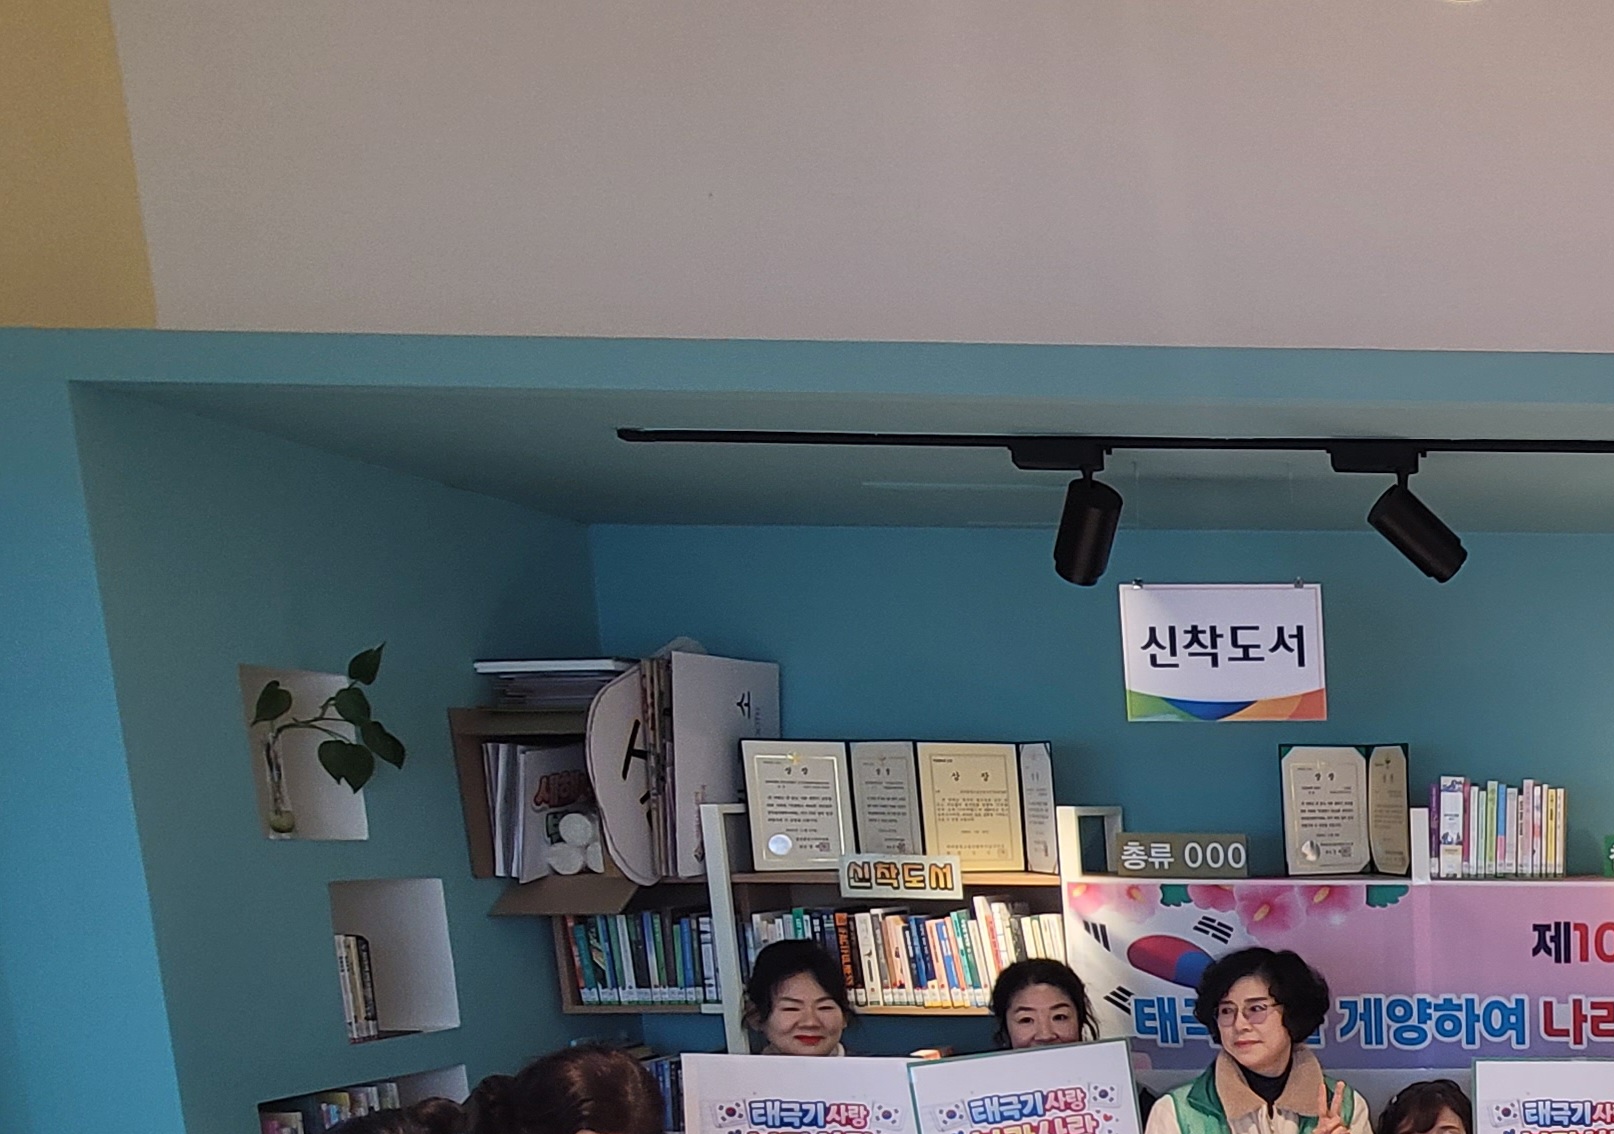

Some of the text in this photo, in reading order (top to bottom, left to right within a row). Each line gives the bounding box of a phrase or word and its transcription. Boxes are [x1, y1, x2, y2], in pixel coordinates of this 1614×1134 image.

[1140, 625, 1305, 668] 신착도서
[1121, 841, 1246, 870] 총류 000
[847, 861, 954, 891] 신착도서
[1339, 997, 1526, 1046] 게양하여
